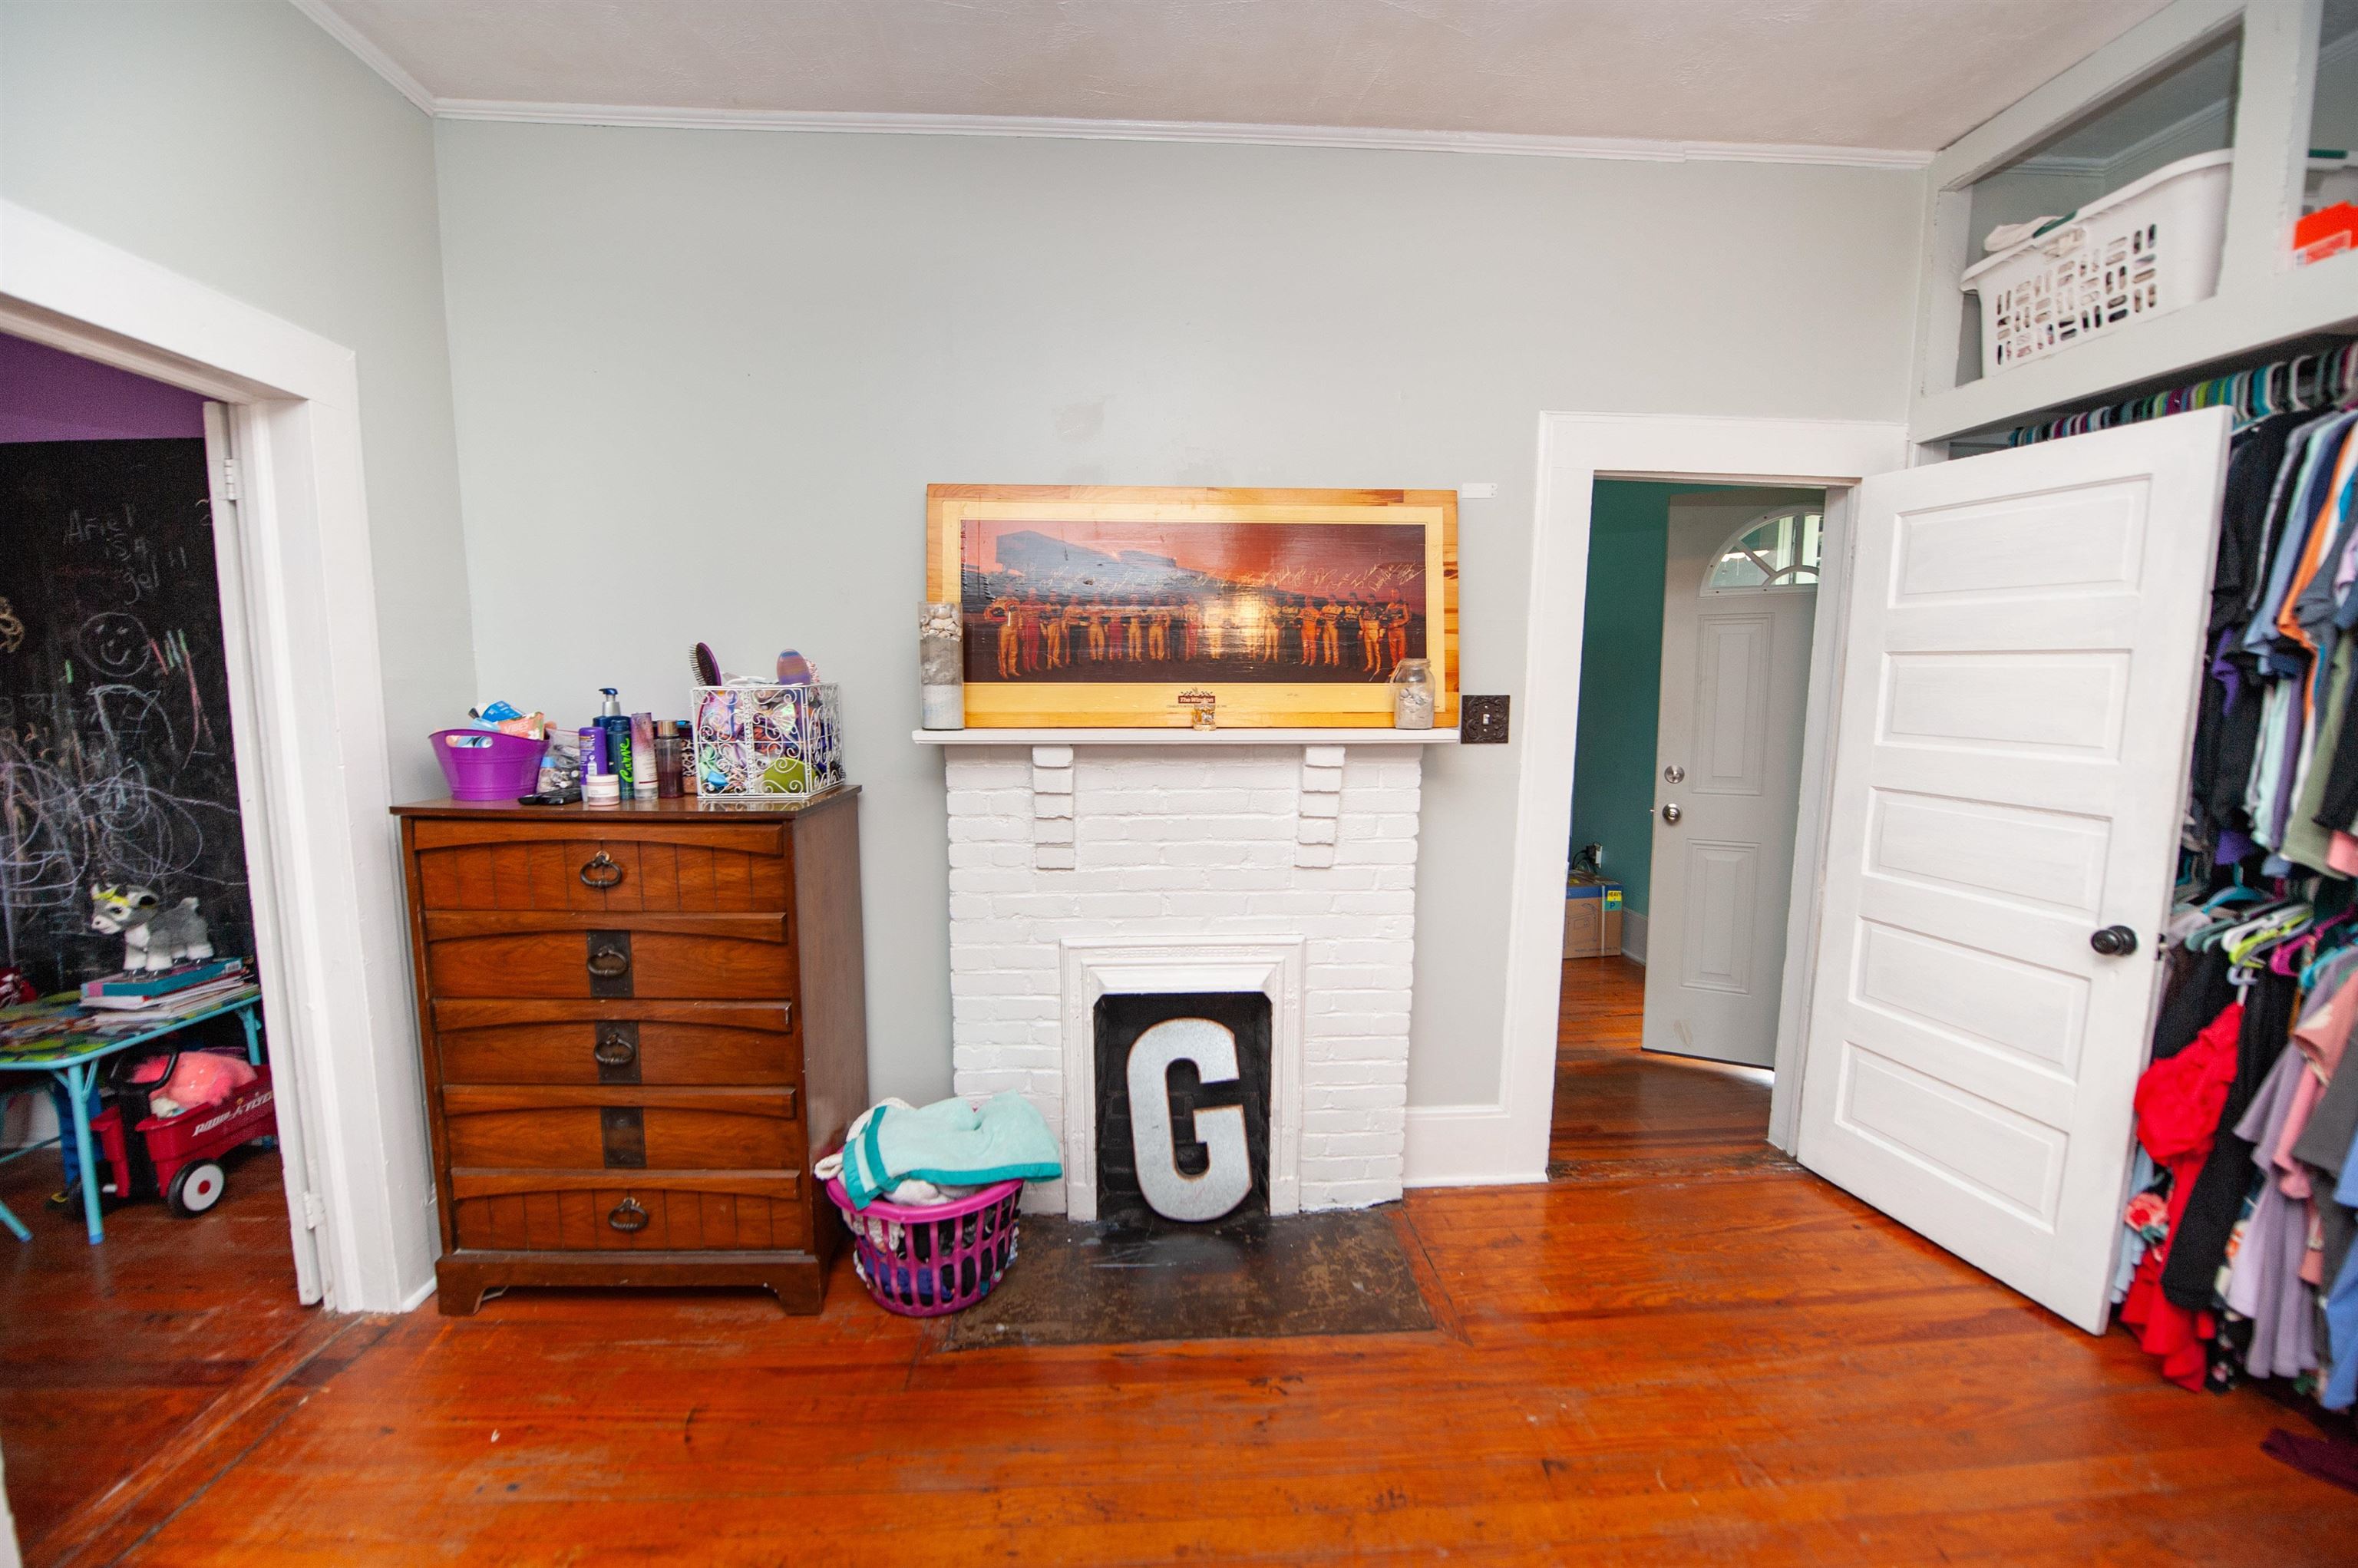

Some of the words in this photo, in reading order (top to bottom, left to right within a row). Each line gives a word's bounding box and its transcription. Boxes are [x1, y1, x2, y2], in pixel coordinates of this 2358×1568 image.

[504, 721, 528, 734] VIBES
[619, 738, 633, 783] Curve
[1126, 1016, 1253, 1222] G
